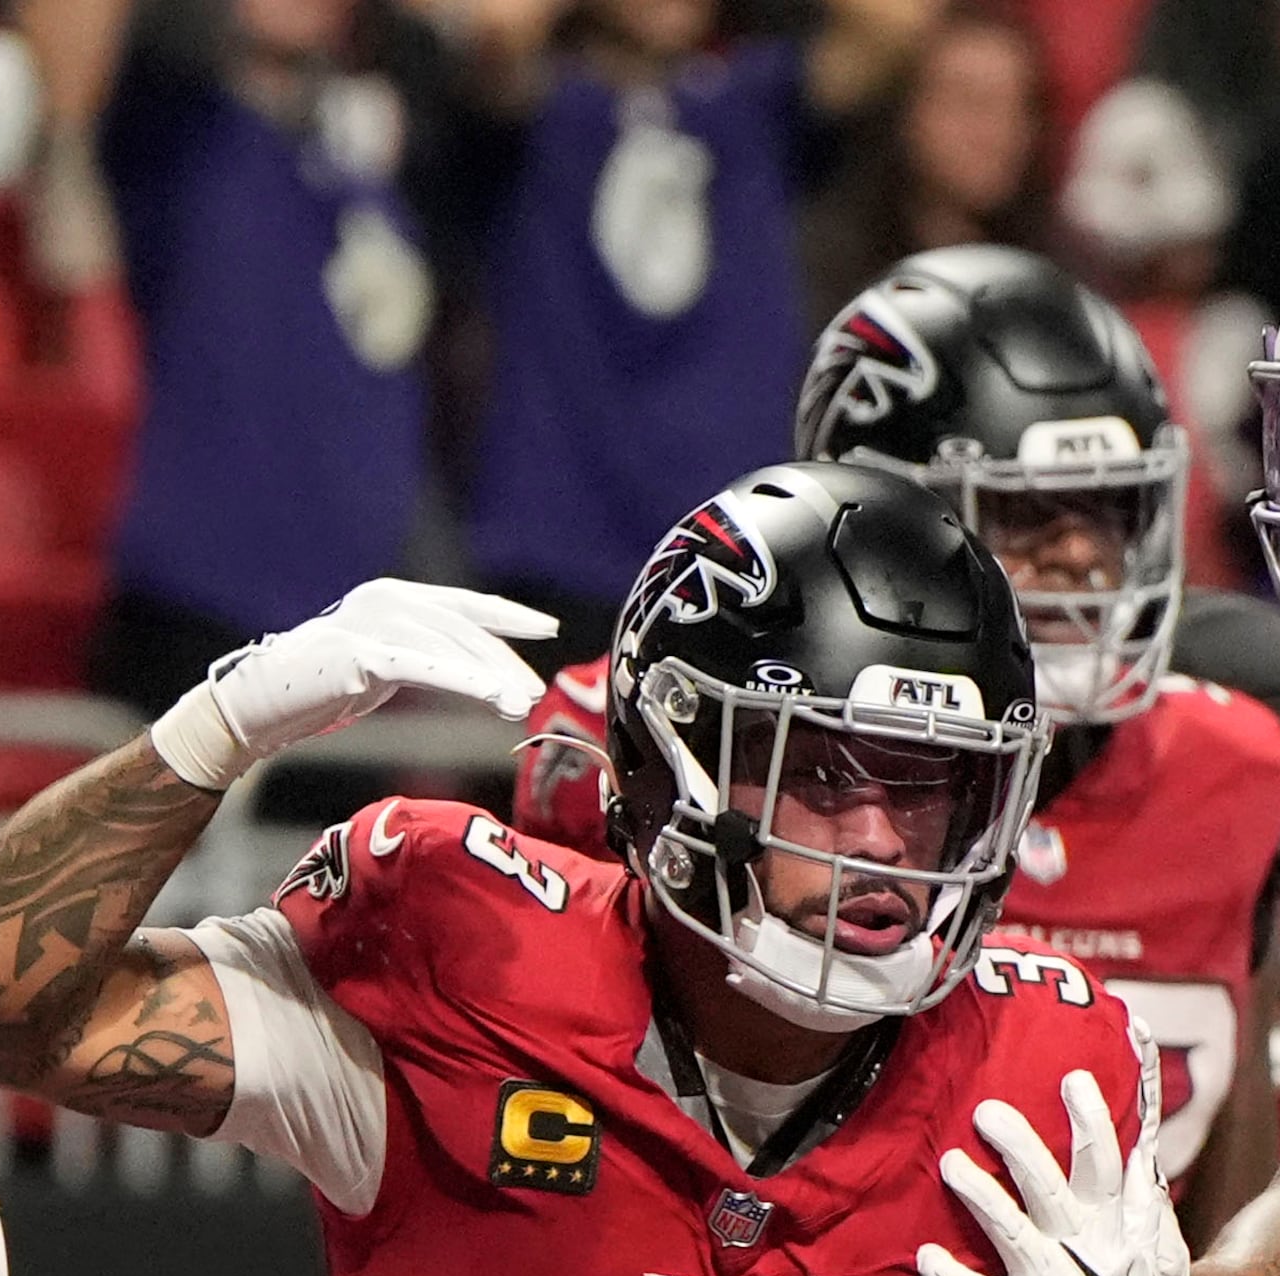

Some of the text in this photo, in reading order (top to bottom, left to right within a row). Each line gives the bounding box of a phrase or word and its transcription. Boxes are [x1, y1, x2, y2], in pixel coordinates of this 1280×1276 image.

[889, 675, 961, 710] ATL
[463, 814, 570, 913] 3
[971, 945, 1096, 1009] 3
[500, 1089, 595, 1165] C
[715, 1211, 754, 1240] NFL
